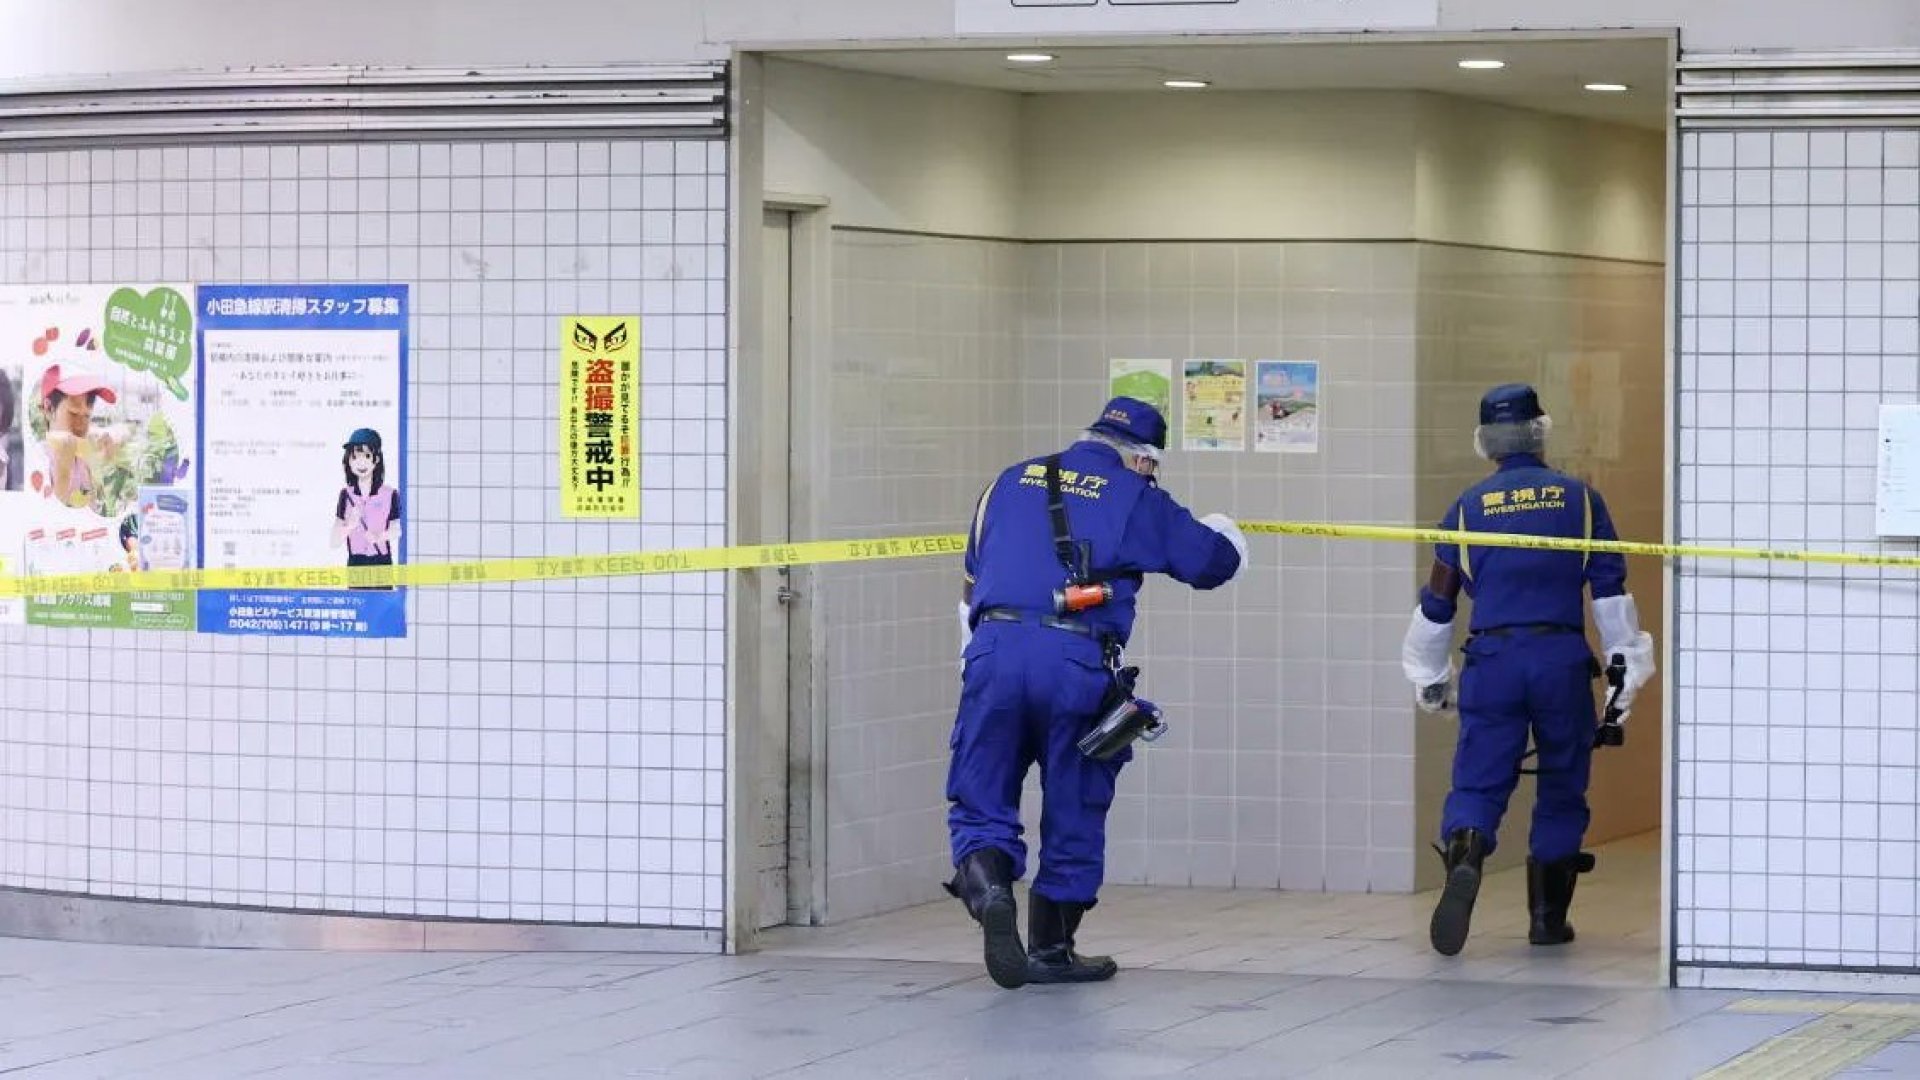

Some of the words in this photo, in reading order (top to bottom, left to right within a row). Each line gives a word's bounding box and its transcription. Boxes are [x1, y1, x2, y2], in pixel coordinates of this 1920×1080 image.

[206, 298, 399, 316] 小田急線駅清掃スタッフ募集
[585, 359, 615, 492] 盗撮警戒中
[1482, 485, 1565, 507] 警視庁
[1483, 501, 1565, 517] INVESTIGATION
